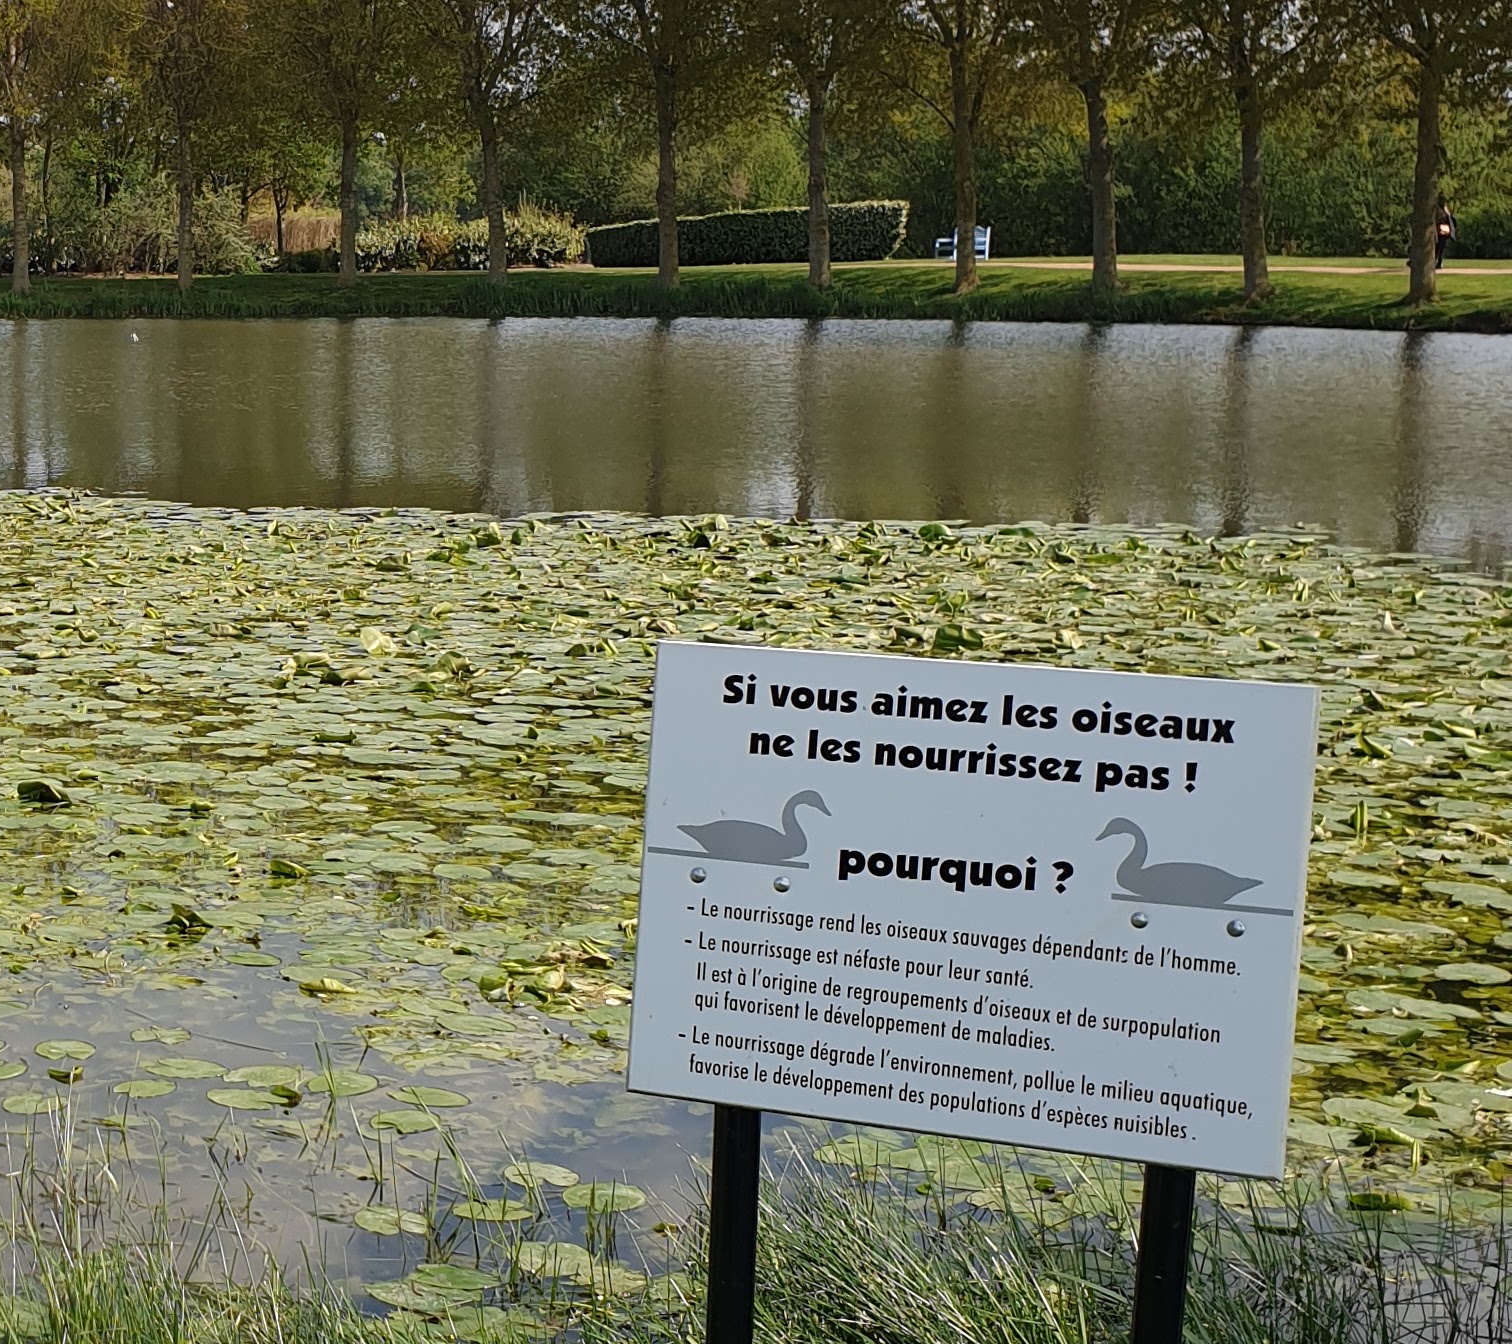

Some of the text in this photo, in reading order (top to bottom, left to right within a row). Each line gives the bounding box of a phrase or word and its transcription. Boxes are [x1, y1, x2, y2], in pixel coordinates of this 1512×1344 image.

[723, 673, 1235, 743] Si vous aimez les oiseaux
[749, 729, 1198, 793] ne les nourrissez pas !
[838, 850, 1074, 894] pourquoi ?
[699, 931, 717, 950] Le
[722, 937, 811, 964] nourrissage
[817, 950, 838, 966] est
[843, 950, 900, 972] néfaste
[905, 961, 945, 978] pour
[949, 959, 981, 982] leur
[985, 967, 1034, 989] santé.
[701, 898, 718, 917] Le
[724, 906, 814, 931] nourrissage
[820, 913, 855, 933] rend
[861, 914, 882, 935] les
[887, 920, 947, 944] oiseaux
[952, 932, 1027, 954] sauvages
[1032, 934, 1128, 963] dépendants
[1134, 944, 1154, 966] de
[695, 991, 1055, 1051] qui favorisent le développement de maladies.
[697, 962, 706, 981] Il
[712, 968, 733, 984] est
[738, 967, 746, 986] à
[823, 977, 841, 997] de
[847, 986, 968, 1013] regroupements
[1056, 1009, 1072, 1025] et
[1077, 1007, 1096, 1028] de
[1101, 1017, 1221, 1044] surpopulation
[690, 1053, 749, 1079] favorise
[754, 1061, 767, 1082] le
[773, 1066, 894, 1099] développement
[898, 1082, 925, 1104] des
[930, 1089, 1026, 1118] populations
[693, 1025, 710, 1045] Le
[715, 1034, 805, 1058] nourrissage
[810, 1040, 875, 1066] dégrade
[1023, 1071, 1075, 1093] pollue
[1081, 1075, 1095, 1096] le
[1101, 1080, 1154, 1103] milieu
[1160, 1092, 1253, 1119] aquatique,
